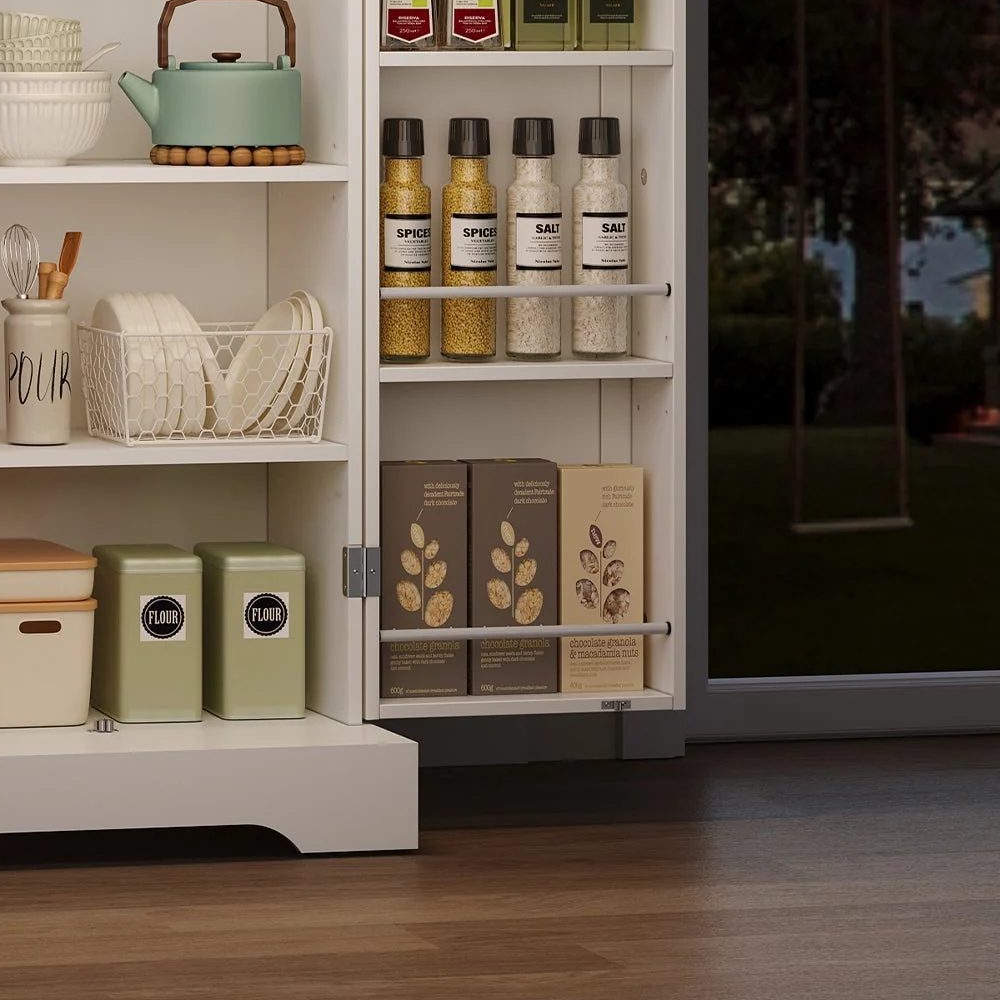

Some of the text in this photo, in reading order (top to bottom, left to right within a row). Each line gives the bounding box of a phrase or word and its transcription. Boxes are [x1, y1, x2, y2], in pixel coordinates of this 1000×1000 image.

[535, 223, 560, 234] SALT
[601, 223, 626, 233] SALT
[7, 349, 72, 405] POUR
[148, 610, 179, 625] FLOUR
[251, 607, 282, 622] FLOUR
[429, 640, 460, 652] granola
[480, 638, 550, 649] chocolate granola
[569, 636, 637, 648] chocolate granola
[569, 648, 639, 659] & macadamia nuts
[390, 687, 404, 695] 600g
[480, 684, 494, 693] 600g
